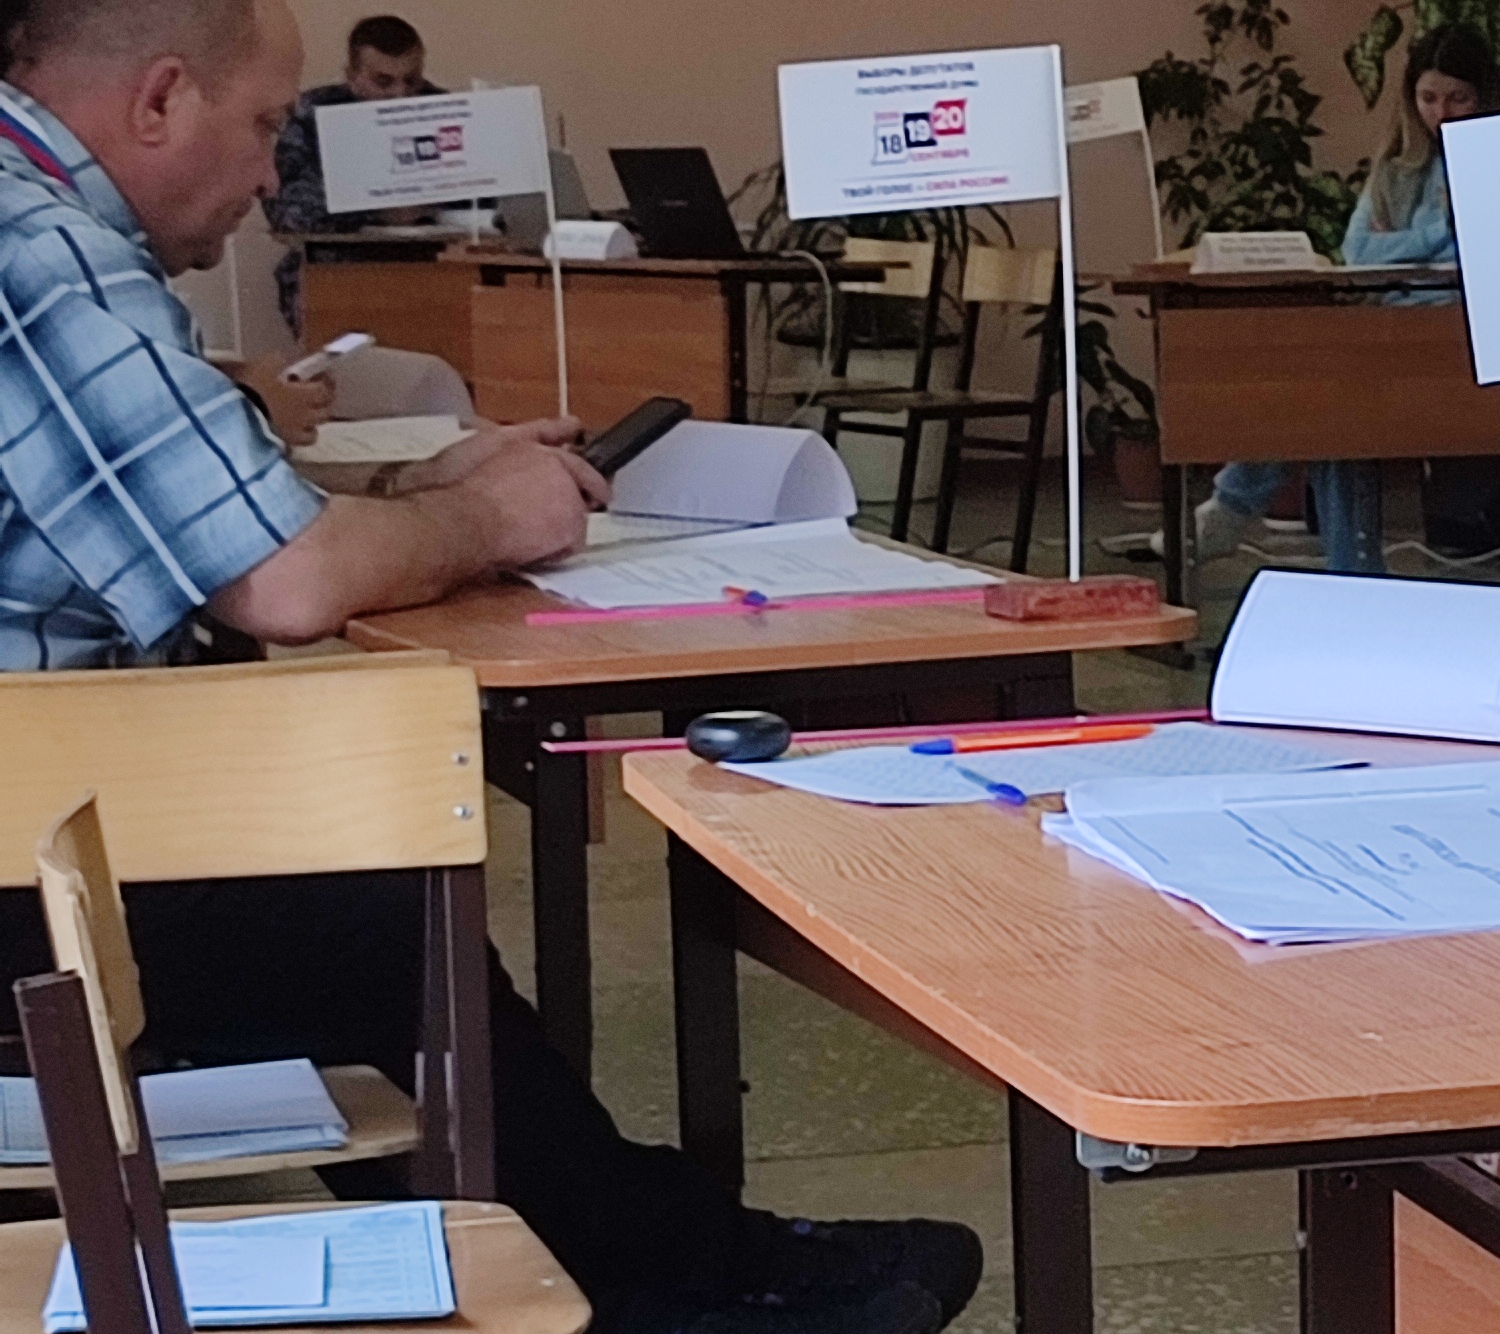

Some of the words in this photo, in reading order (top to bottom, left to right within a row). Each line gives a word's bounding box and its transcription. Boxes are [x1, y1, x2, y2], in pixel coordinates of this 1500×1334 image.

[932, 106, 963, 130] 20
[906, 118, 930, 143] 19
[880, 134, 904, 155] 18
